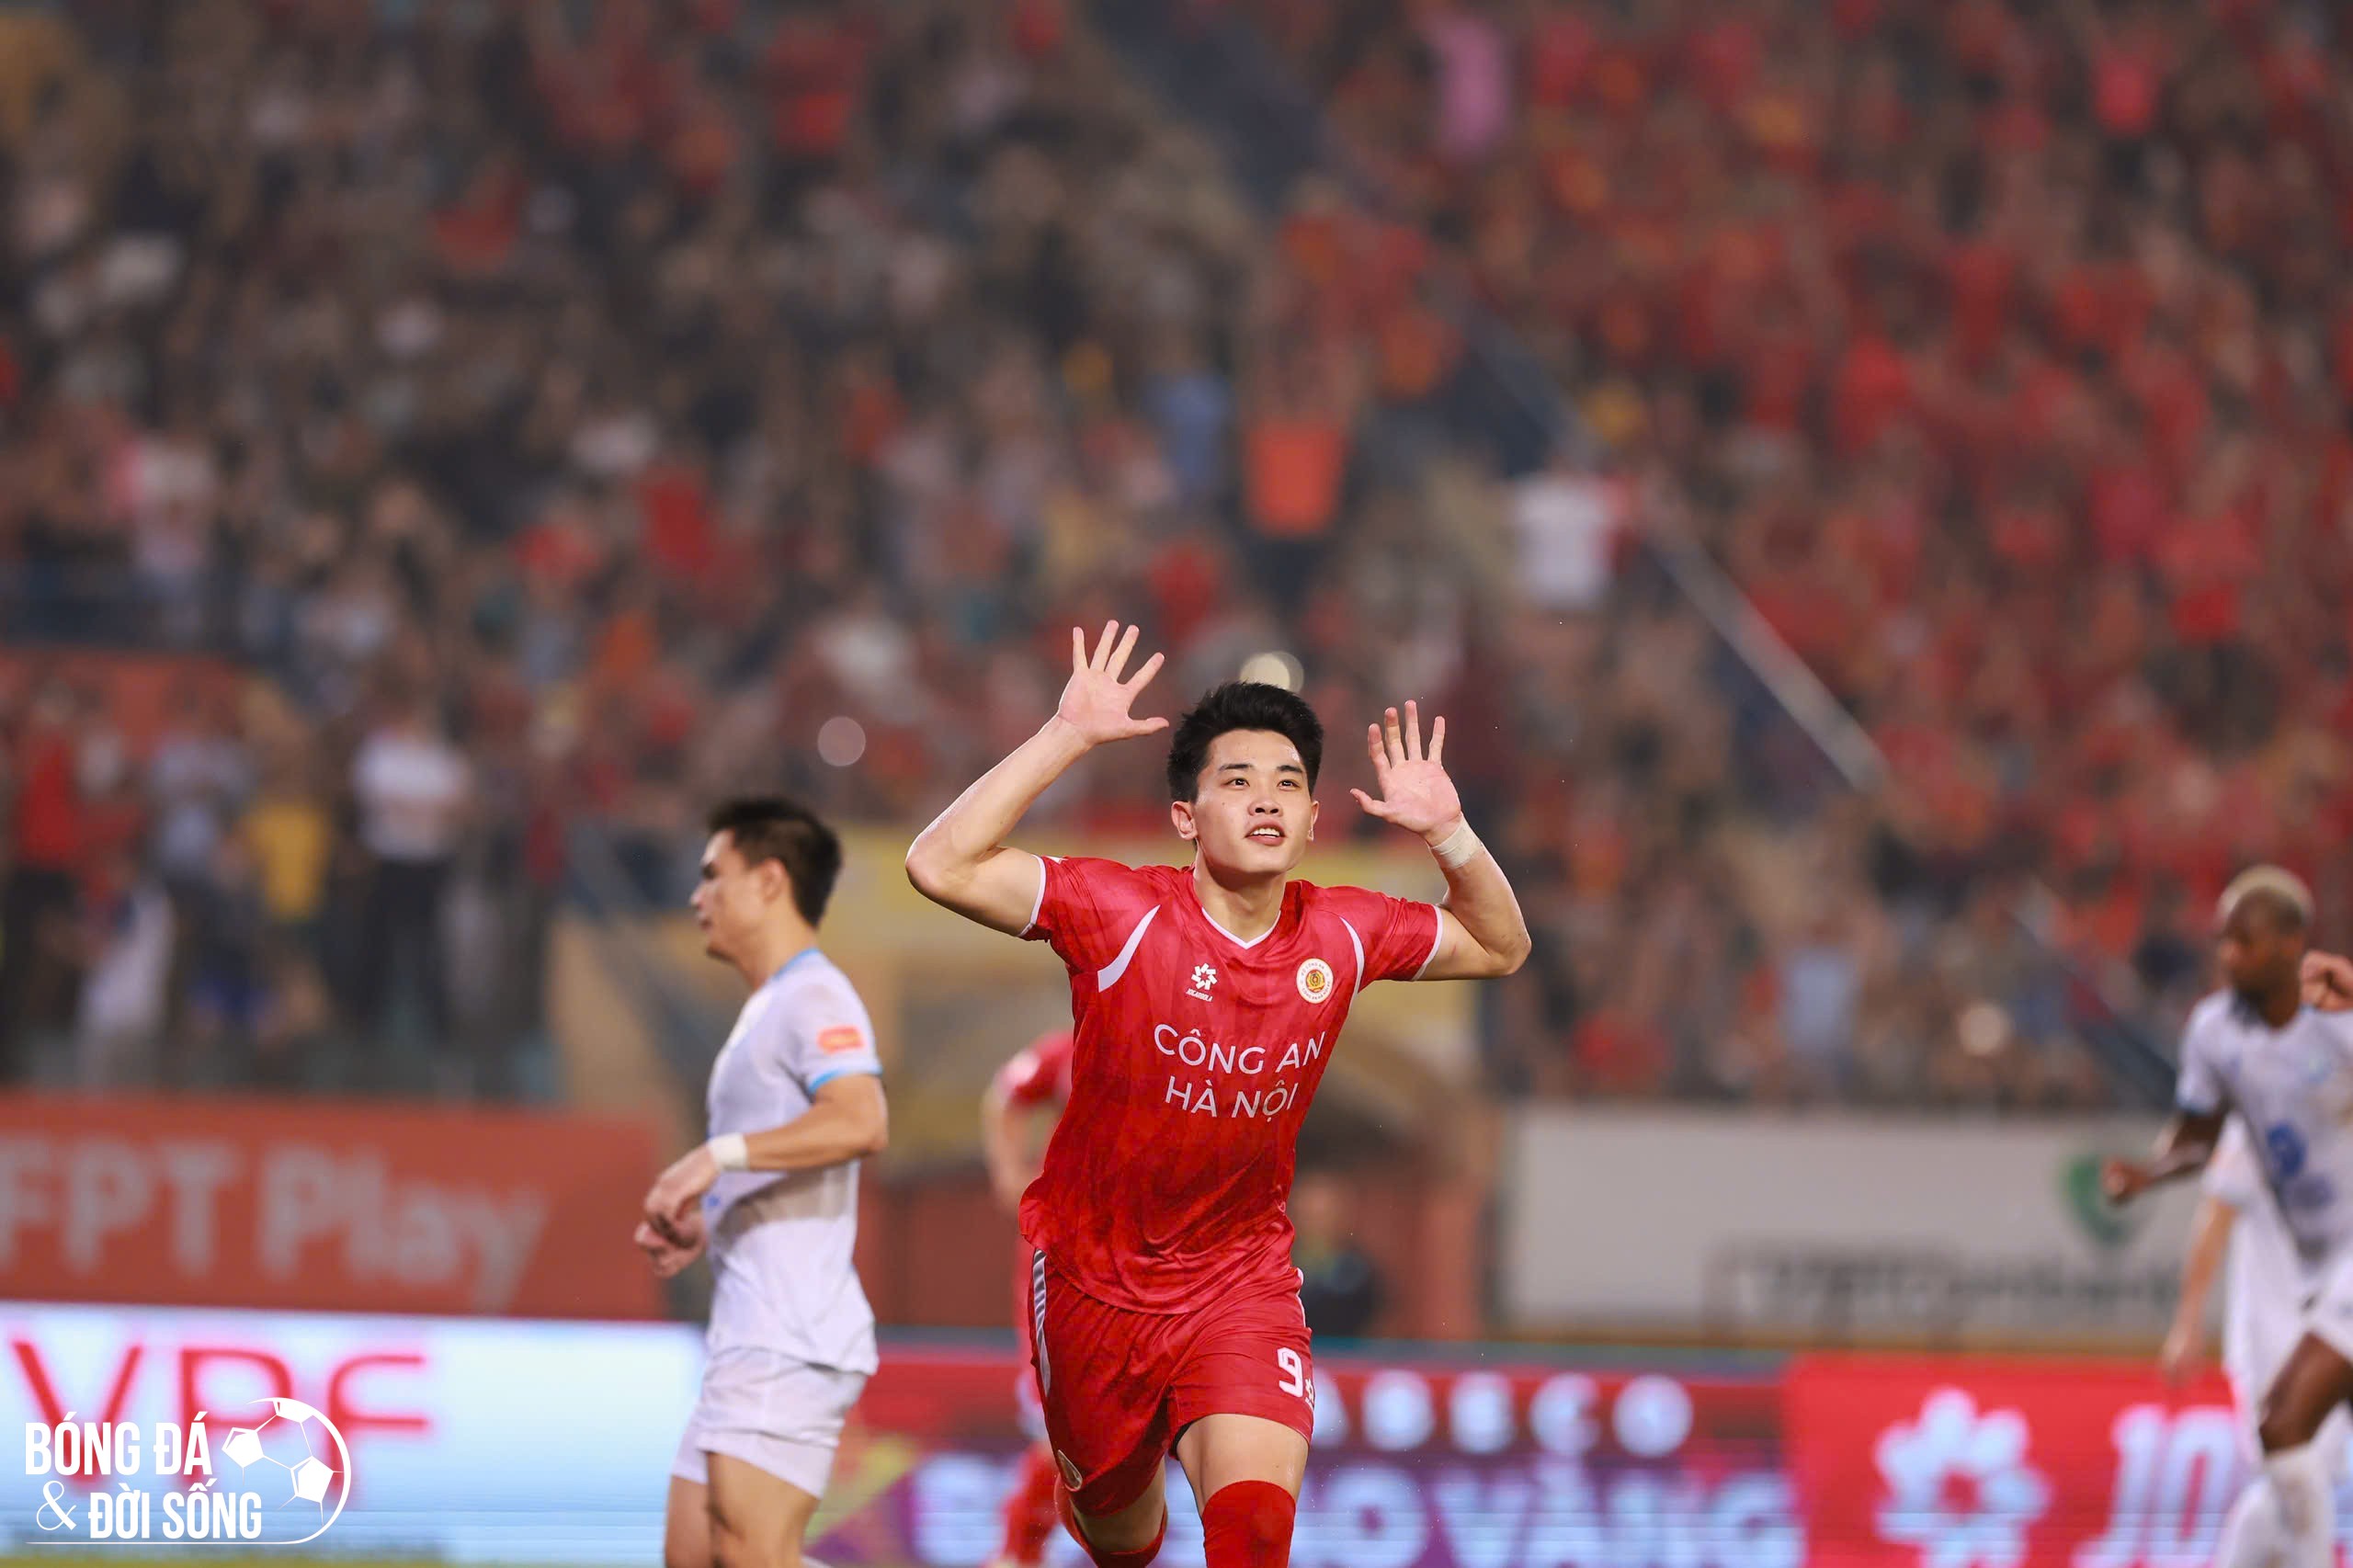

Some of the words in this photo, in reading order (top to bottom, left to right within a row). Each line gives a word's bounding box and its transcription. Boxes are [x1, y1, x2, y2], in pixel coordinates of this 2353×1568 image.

[1154, 1024, 1266, 1074] CÔNG
[1275, 1031, 1325, 1074] AN
[1165, 1076, 1218, 1118] HÀ
[1232, 1080, 1299, 1122] NỘI
[0, 1132, 235, 1281] FPT
[259, 1145, 546, 1316] Play
[1277, 1346, 1303, 1398] 9
[11, 1340, 430, 1507] VPF
